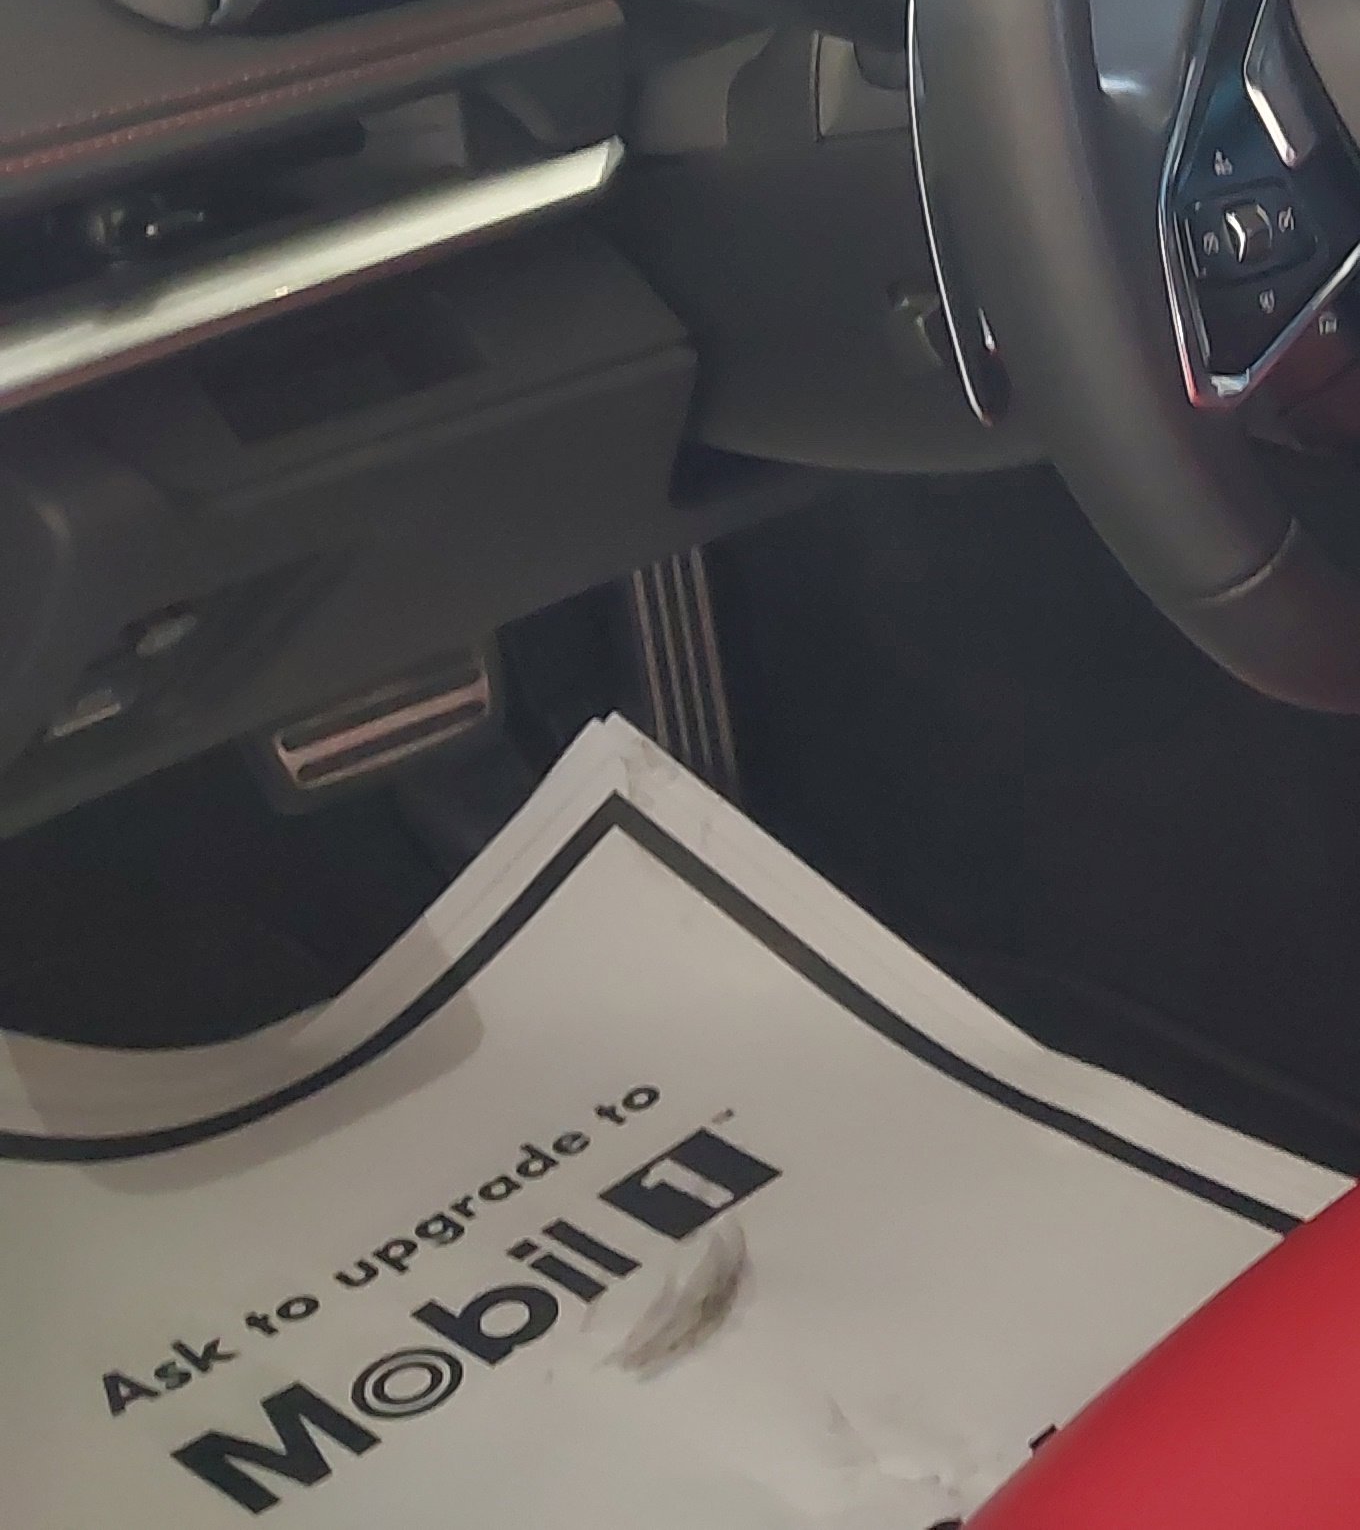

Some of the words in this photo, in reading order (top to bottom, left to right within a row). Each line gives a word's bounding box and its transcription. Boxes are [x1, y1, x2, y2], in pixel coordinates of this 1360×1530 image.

[102, 1337, 239, 1418] Ask
[244, 1294, 321, 1338] to
[333, 1131, 592, 1289] upgrade
[593, 1084, 661, 1127] to
[168, 1217, 644, 1518] Mobil
